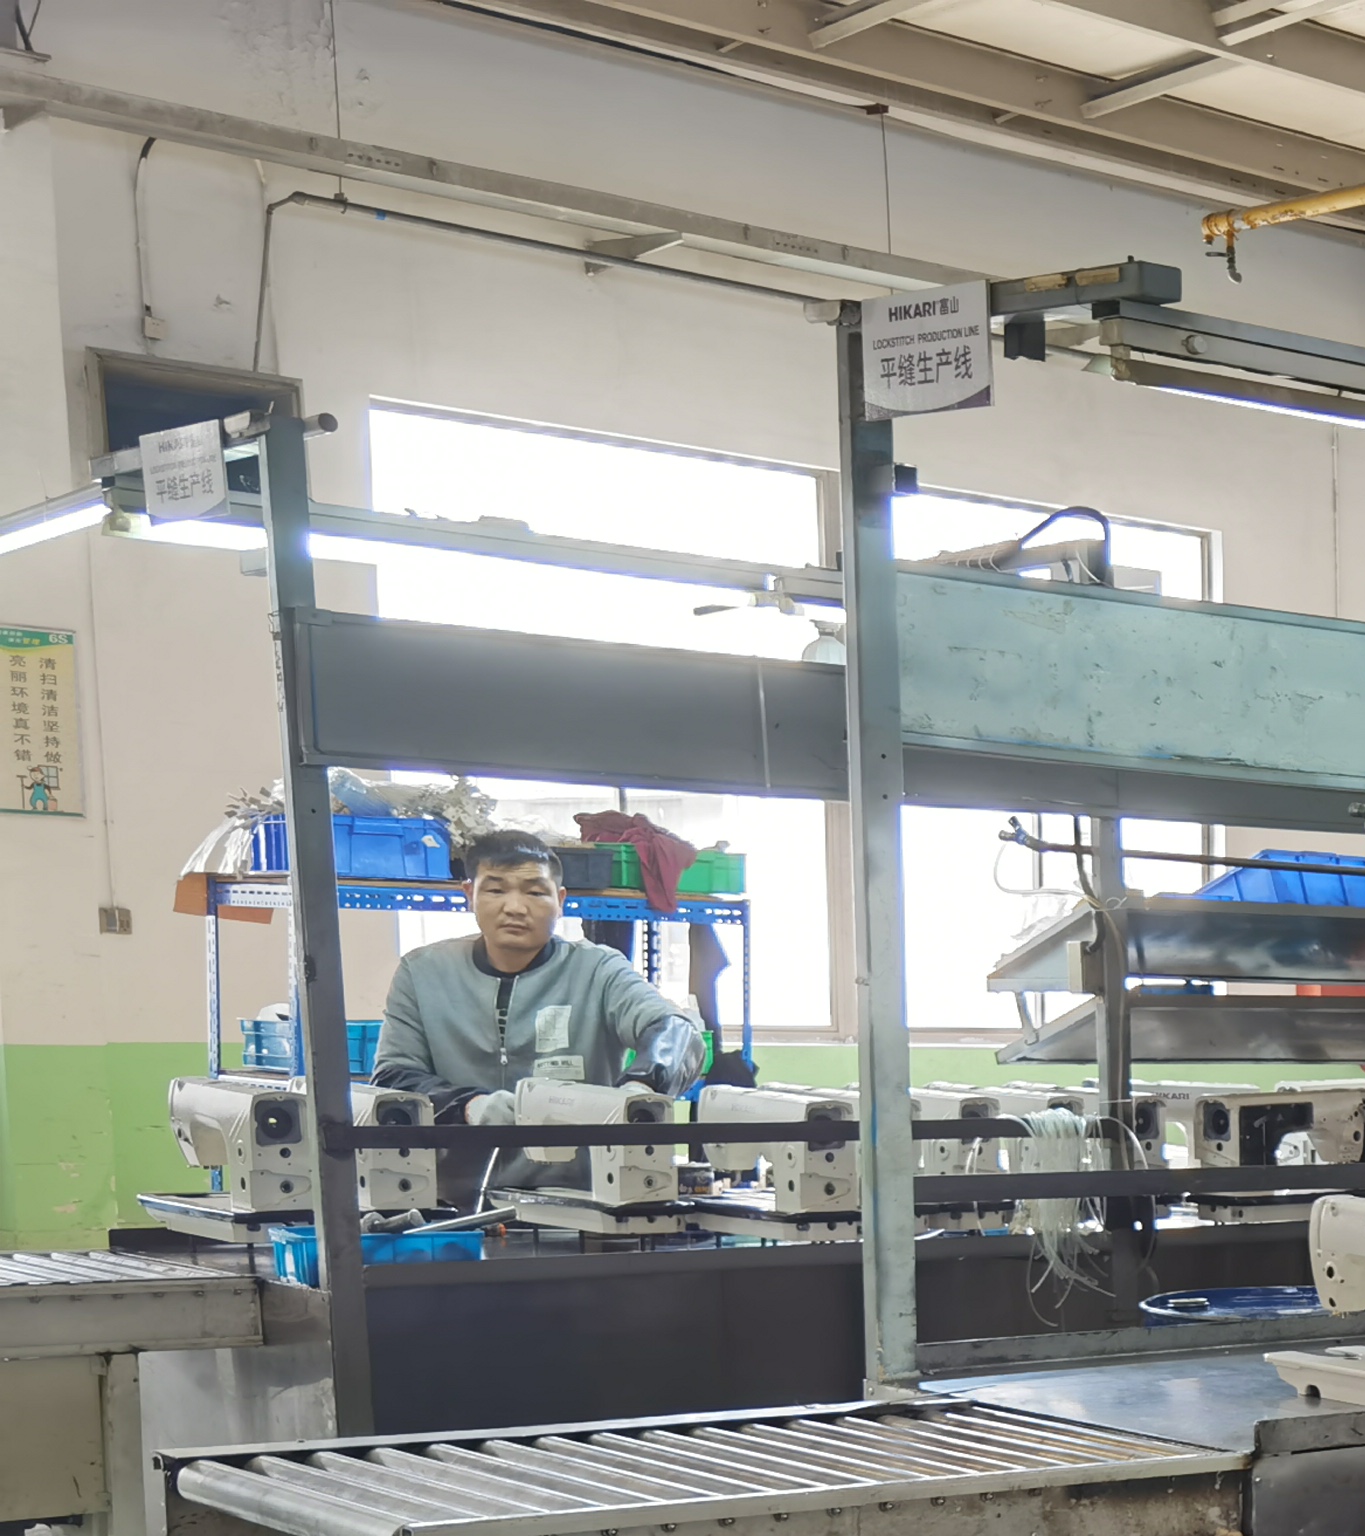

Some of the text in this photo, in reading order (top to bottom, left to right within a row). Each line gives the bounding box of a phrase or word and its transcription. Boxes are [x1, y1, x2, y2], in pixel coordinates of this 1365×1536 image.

[888, 301, 937, 322] HIKARI
[873, 324, 980, 350] LOCKSTITCH PRODUCTION LINE
[880, 345, 972, 389] 平缝生产线
[155, 468, 214, 504] 平缝生产线
[48, 634, 69, 644] 6S
[9, 655, 32, 762] 亮丽环境真不错
[39, 657, 62, 764] 清扫清洁坚持做
